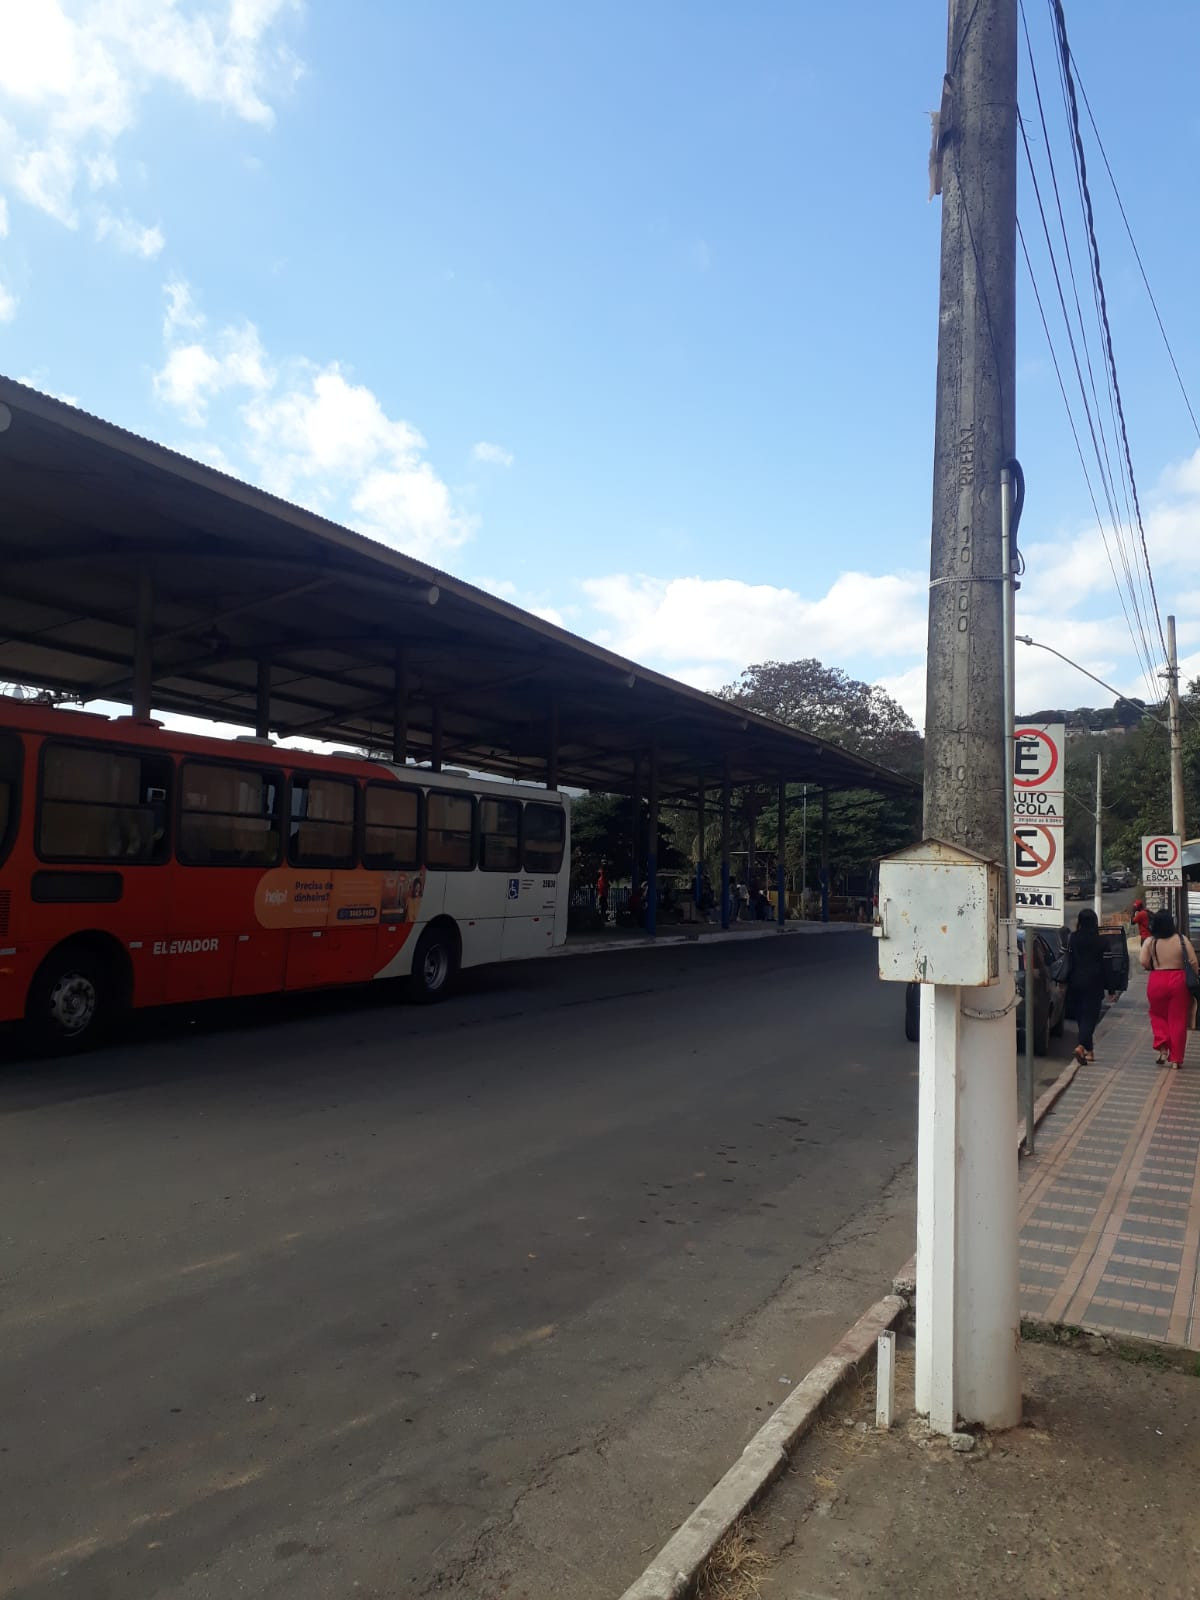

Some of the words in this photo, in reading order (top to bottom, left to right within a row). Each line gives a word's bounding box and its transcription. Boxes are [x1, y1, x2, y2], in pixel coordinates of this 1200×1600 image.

[1015, 741, 1040, 775] E
[1014, 803, 1057, 816] COLA
[1154, 844, 1169, 862] E
[295, 880, 323, 890] Precisa
[324, 880, 334, 890] de
[294, 892, 330, 902] dinheiro?
[1015, 892, 1053, 907] AXI
[153, 938, 219, 955] ELEVADOR
